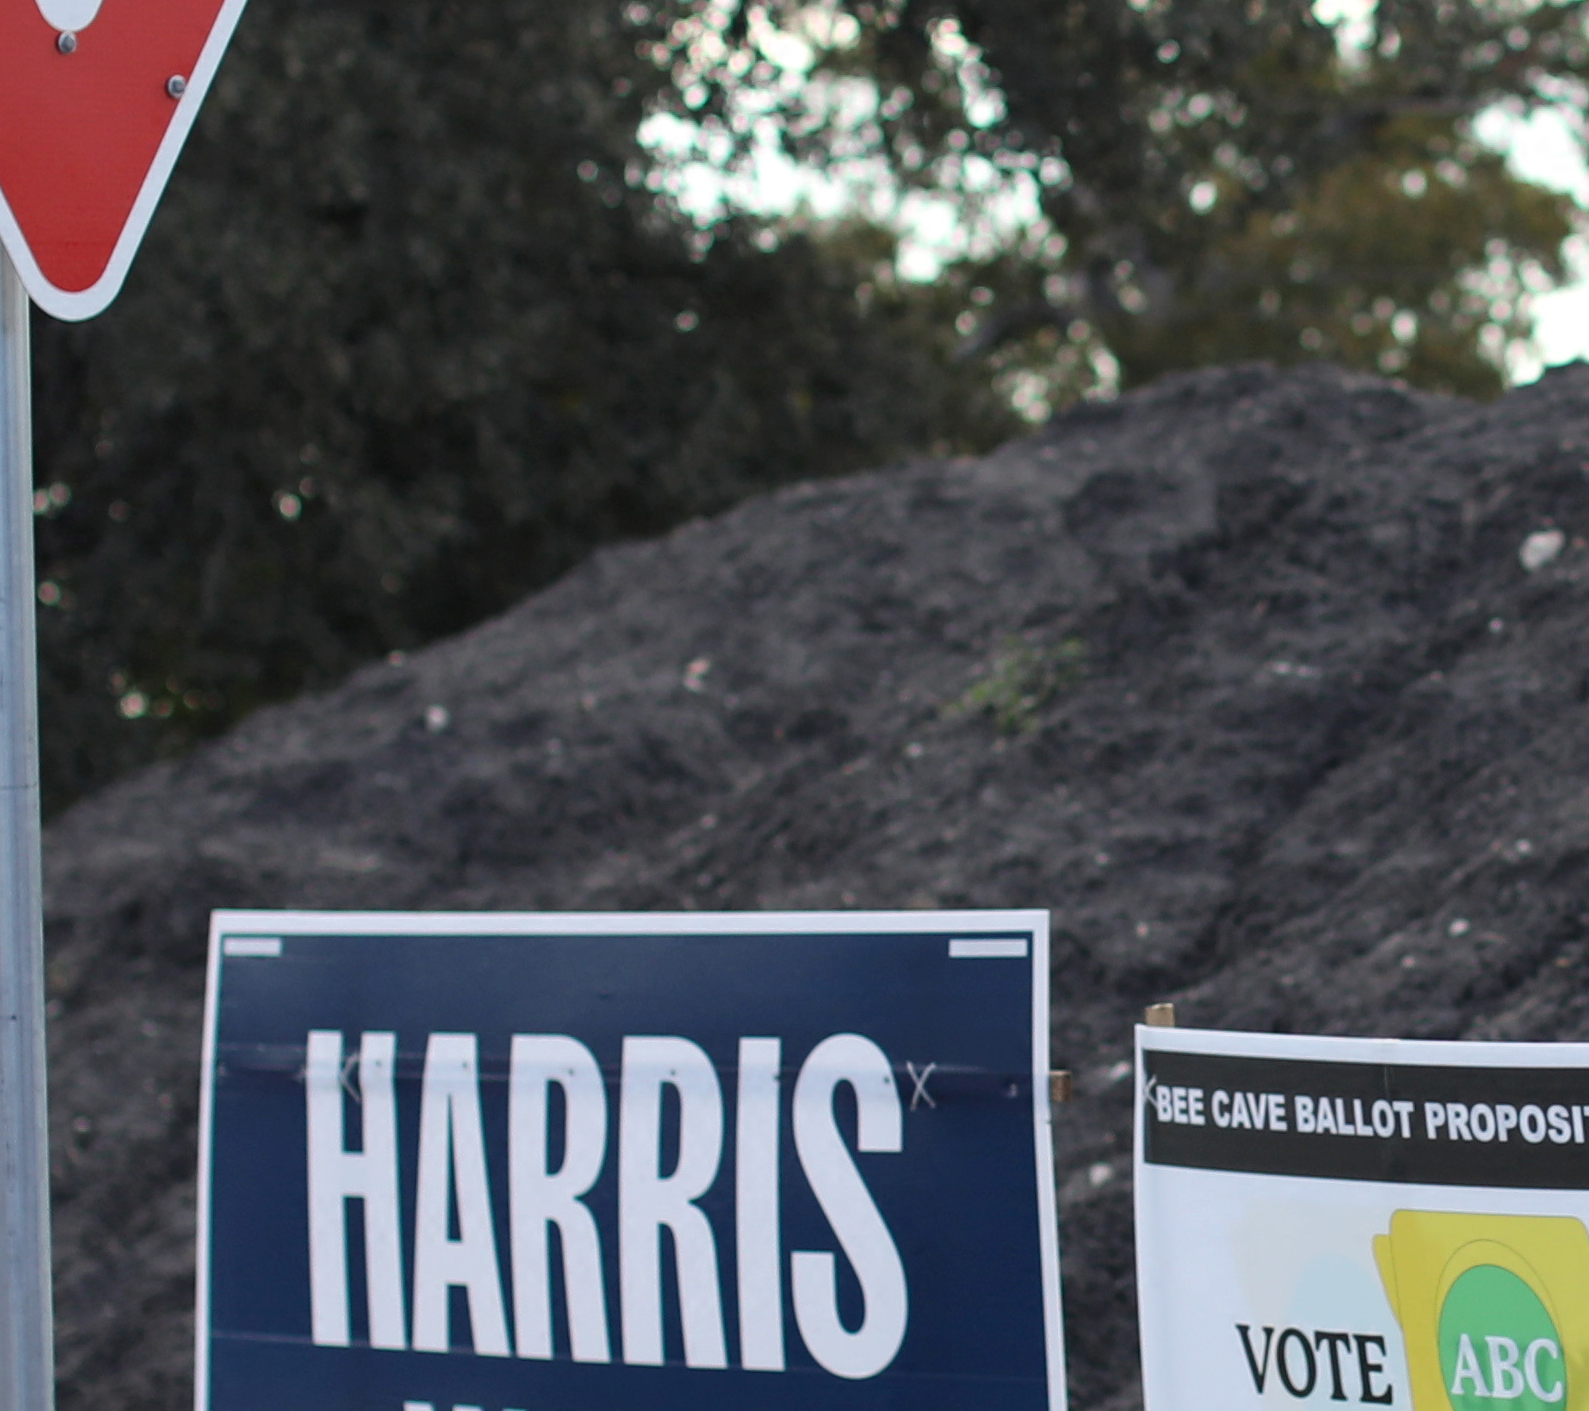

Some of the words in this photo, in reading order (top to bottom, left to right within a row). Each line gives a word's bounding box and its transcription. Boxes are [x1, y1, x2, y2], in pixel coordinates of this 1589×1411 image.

[1156, 1085, 1205, 1126] BEE
[1211, 1089, 1288, 1132] CAVE
[1295, 1095, 1414, 1139] BALLOT
[304, 1030, 909, 1379] HARRIS
[1235, 1323, 1394, 1406] VOTE
[1450, 1332, 1564, 1403] ABC
